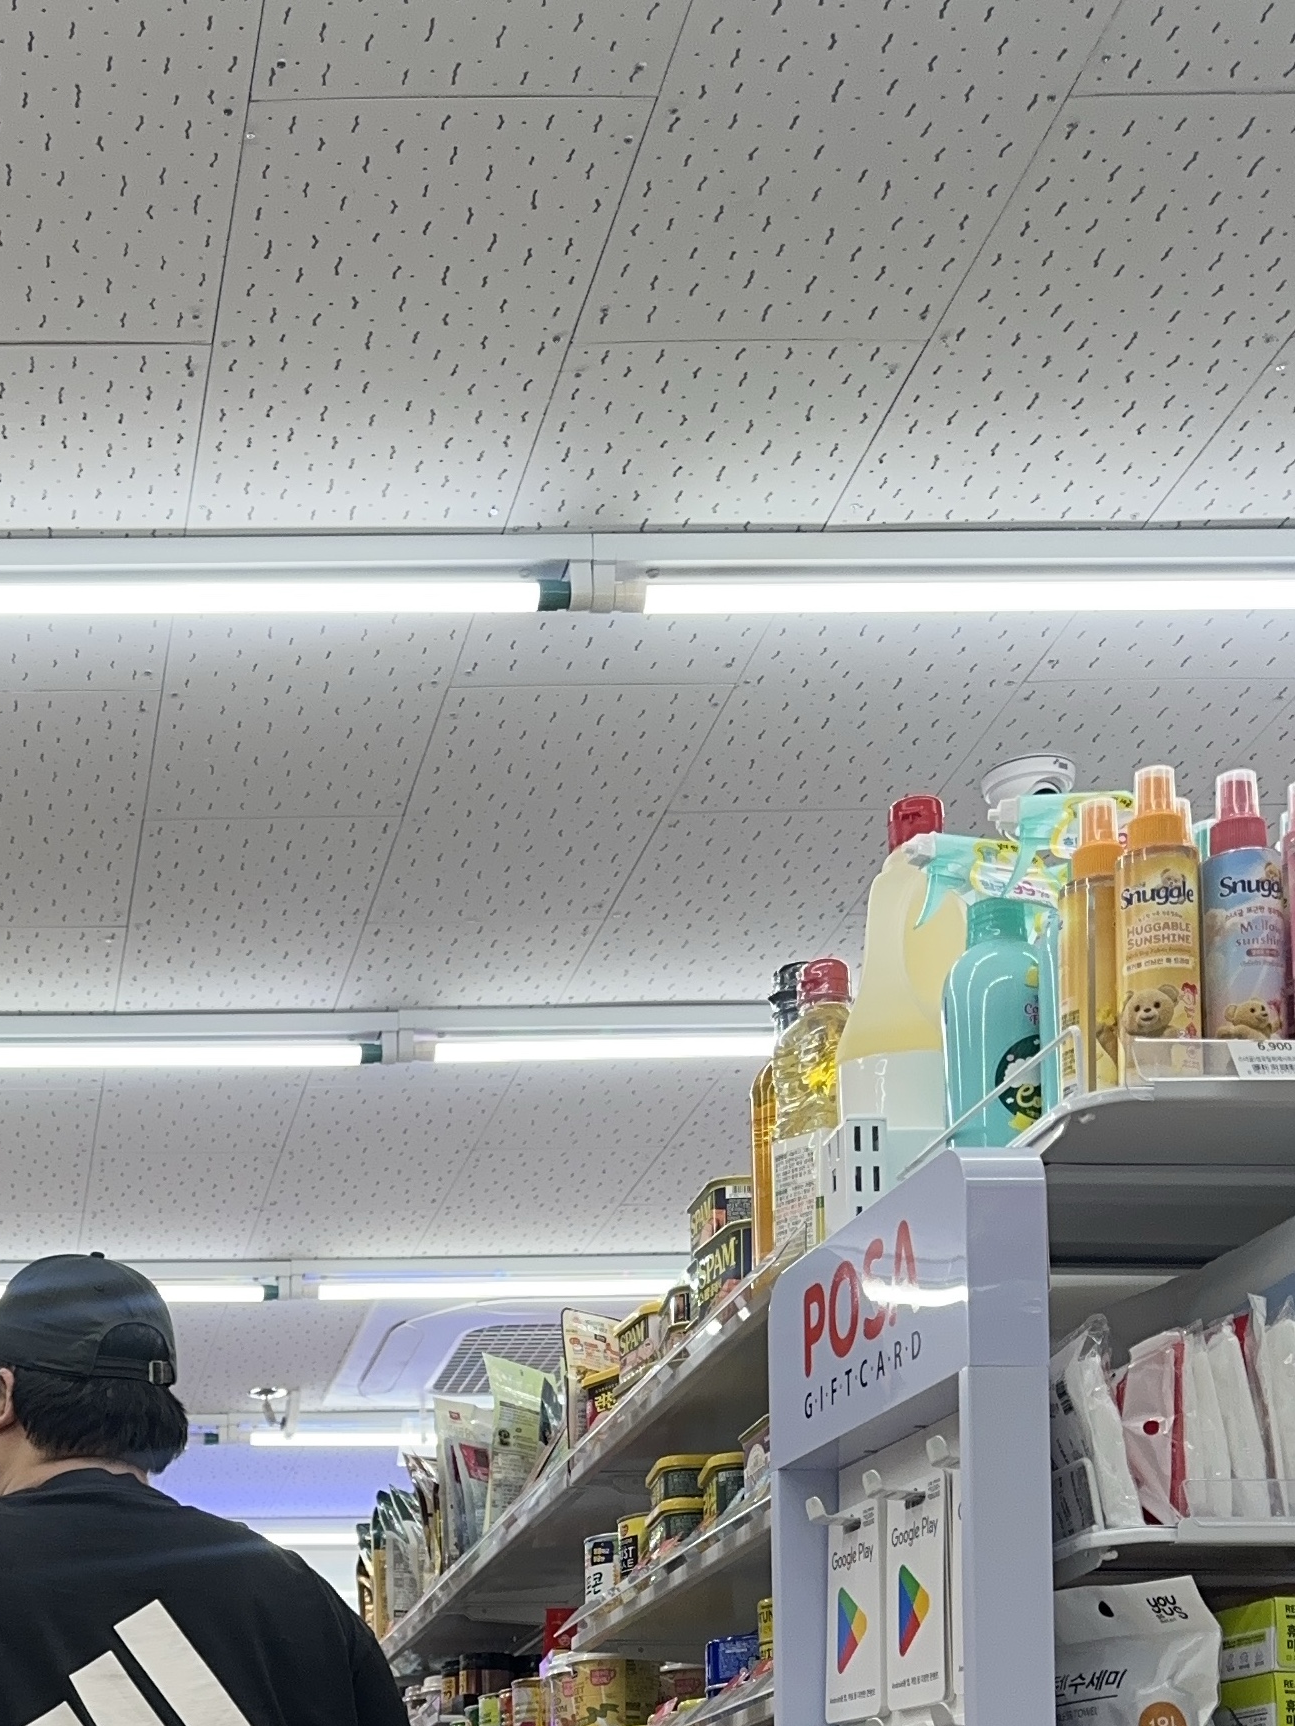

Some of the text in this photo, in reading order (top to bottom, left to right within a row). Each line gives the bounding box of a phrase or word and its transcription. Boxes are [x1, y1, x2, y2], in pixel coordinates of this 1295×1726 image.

[1120, 874, 1195, 910] Snuggle
[1126, 921, 1192, 939] HUGGABLE
[1126, 933, 1192, 951] SUNSHINE
[698, 1236, 738, 1291] SPAM
[803, 1219, 921, 1380] POSA
[619, 1320, 646, 1357] SPAM
[892, 1515, 939, 1548] Google Play
[832, 1542, 874, 1571] Google Play
